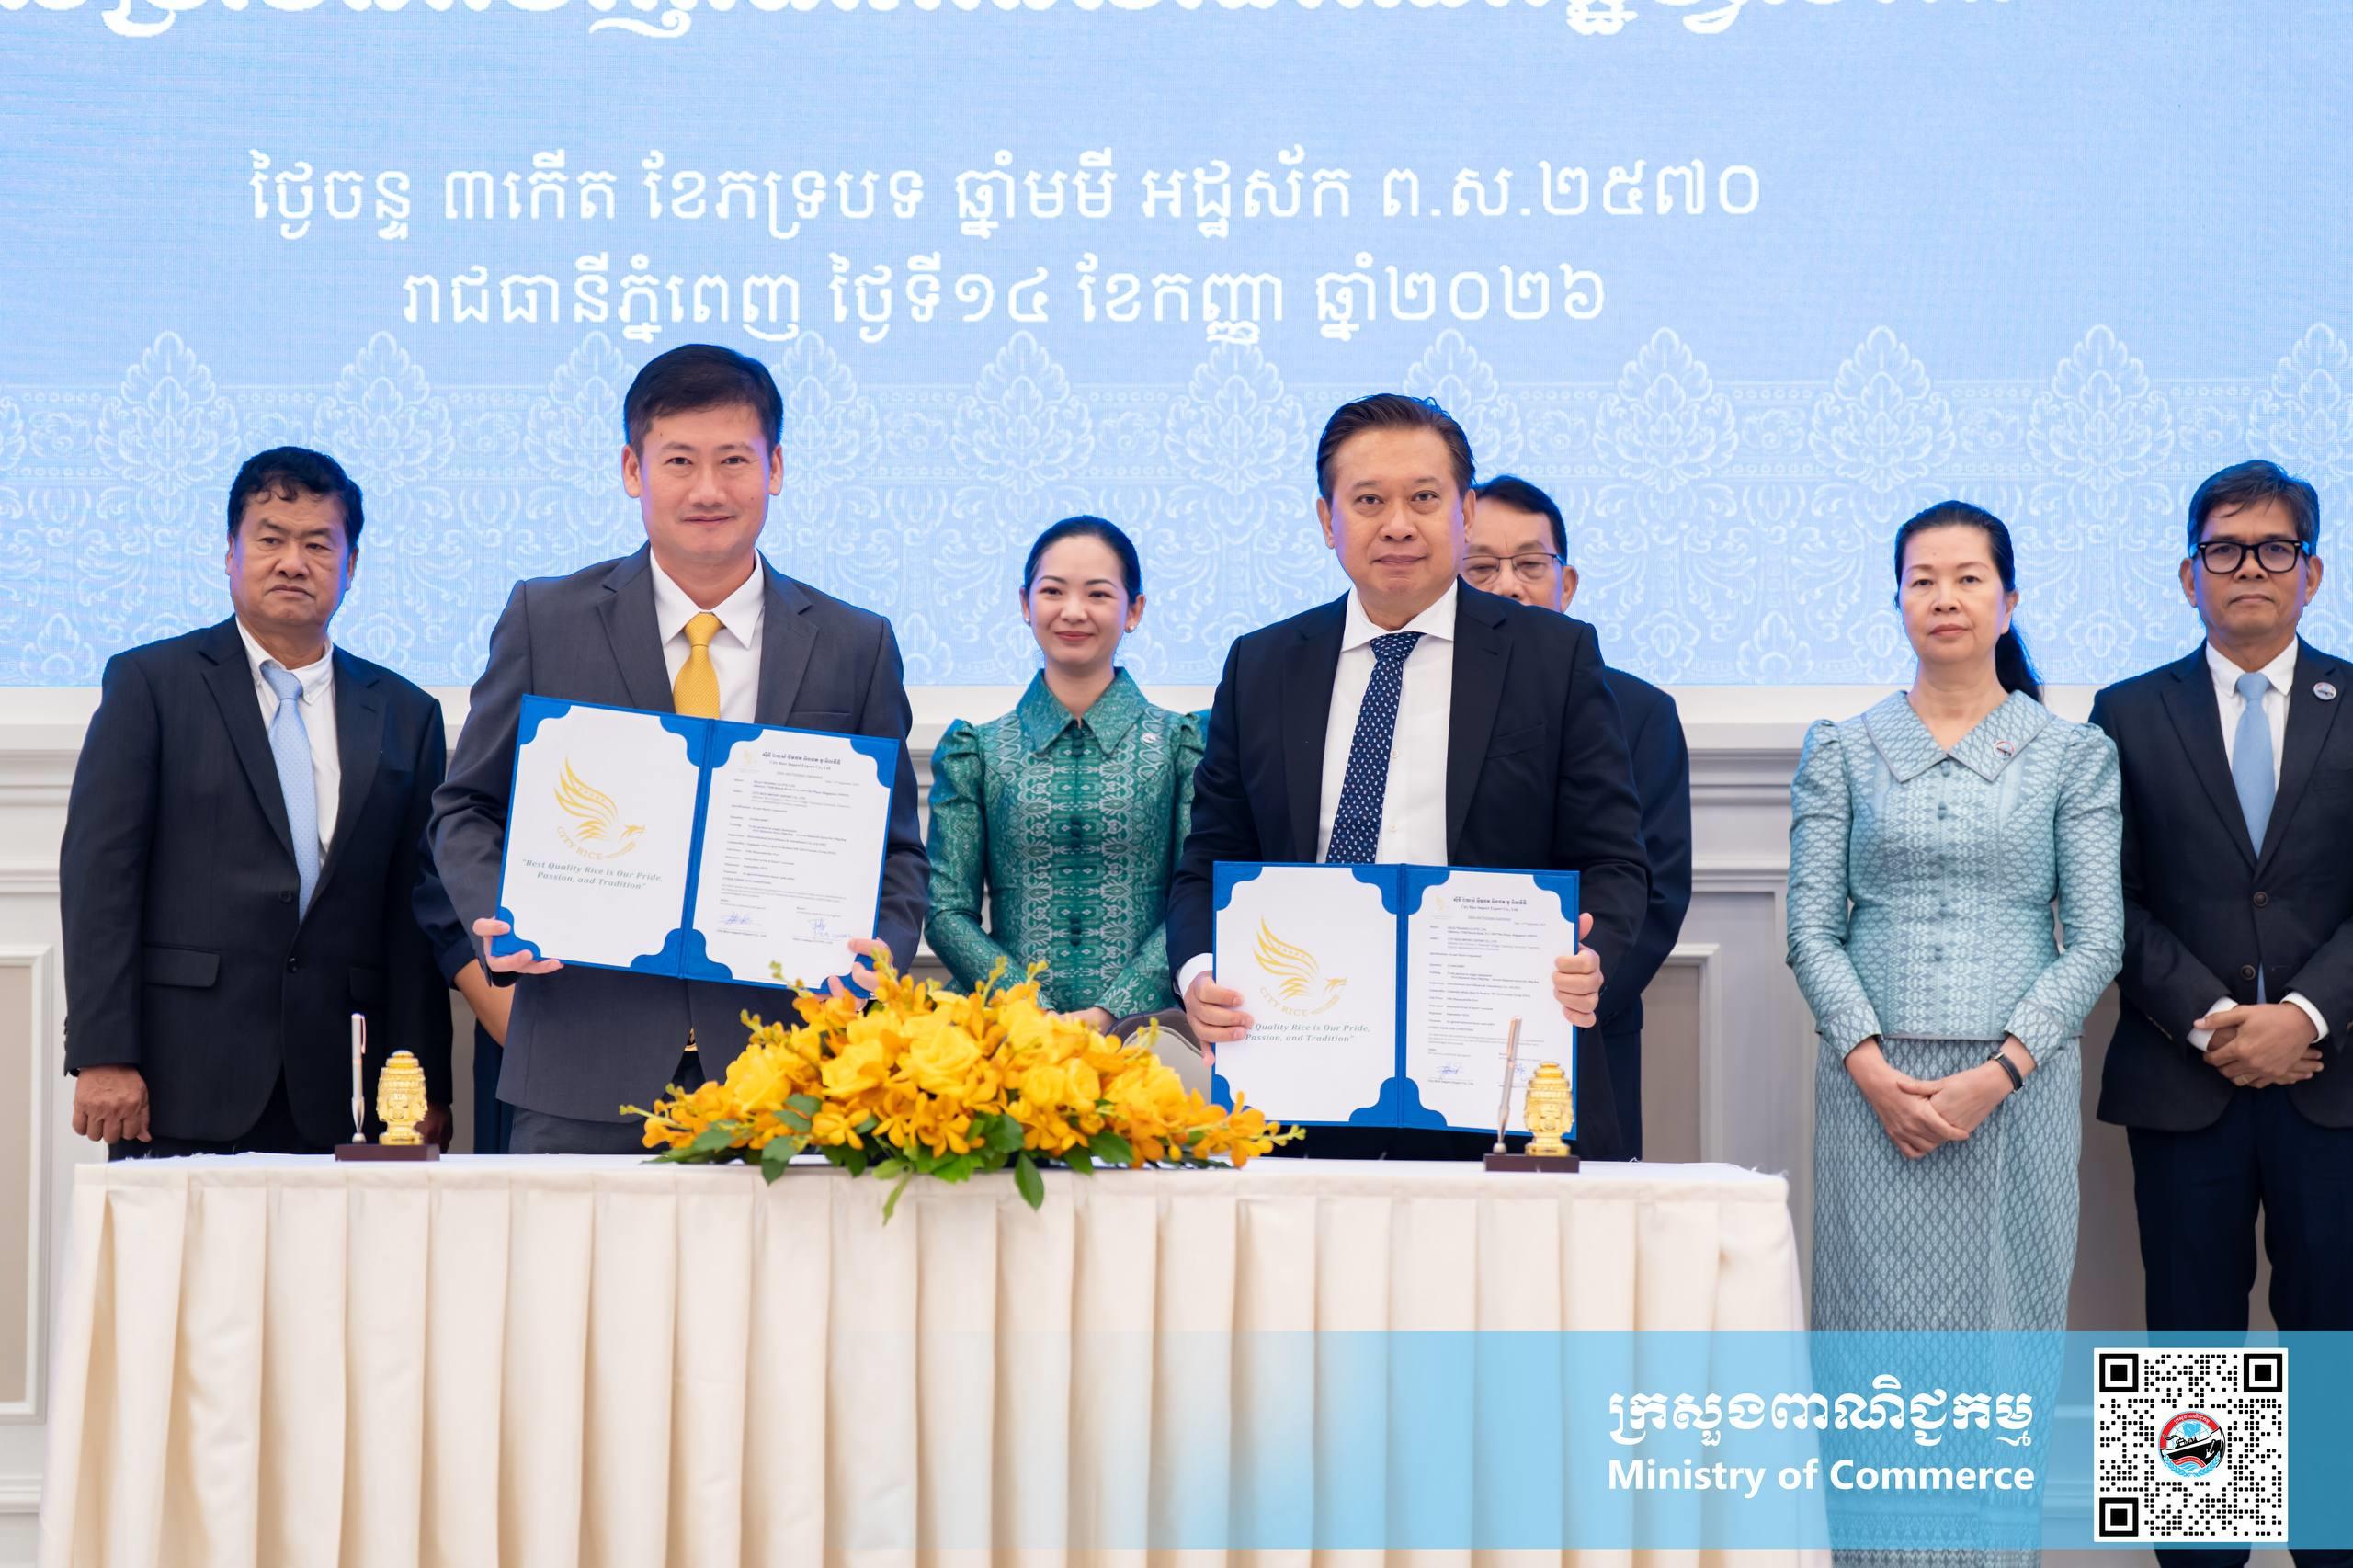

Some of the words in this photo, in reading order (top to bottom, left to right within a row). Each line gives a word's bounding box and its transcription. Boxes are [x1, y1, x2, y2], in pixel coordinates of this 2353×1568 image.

[249, 149, 411, 240] ថ្ងៃចន្ទ
[446, 149, 617, 219] ៣កើត
[642, 149, 924, 239] ខែភទ្របទ
[1382, 158, 1759, 217] ព.ស.២៥៧០
[403, 252, 800, 343] រាជធានីភ្នំពេញ
[829, 252, 1049, 342] ថ្ងៃទី១៤
[1076, 252, 1283, 345] ខែកញ្ញា
[1315, 251, 1605, 342] ឆ្នាំ២០២៦
[575, 847, 604, 860] RICE
[548, 861, 582, 873] Quality
[585, 865, 604, 875] Rice
[606, 868, 614, 876] is
[617, 869, 634, 879] Our
[577, 876, 596, 884] and
[1255, 1023, 1288, 1032] Quality
